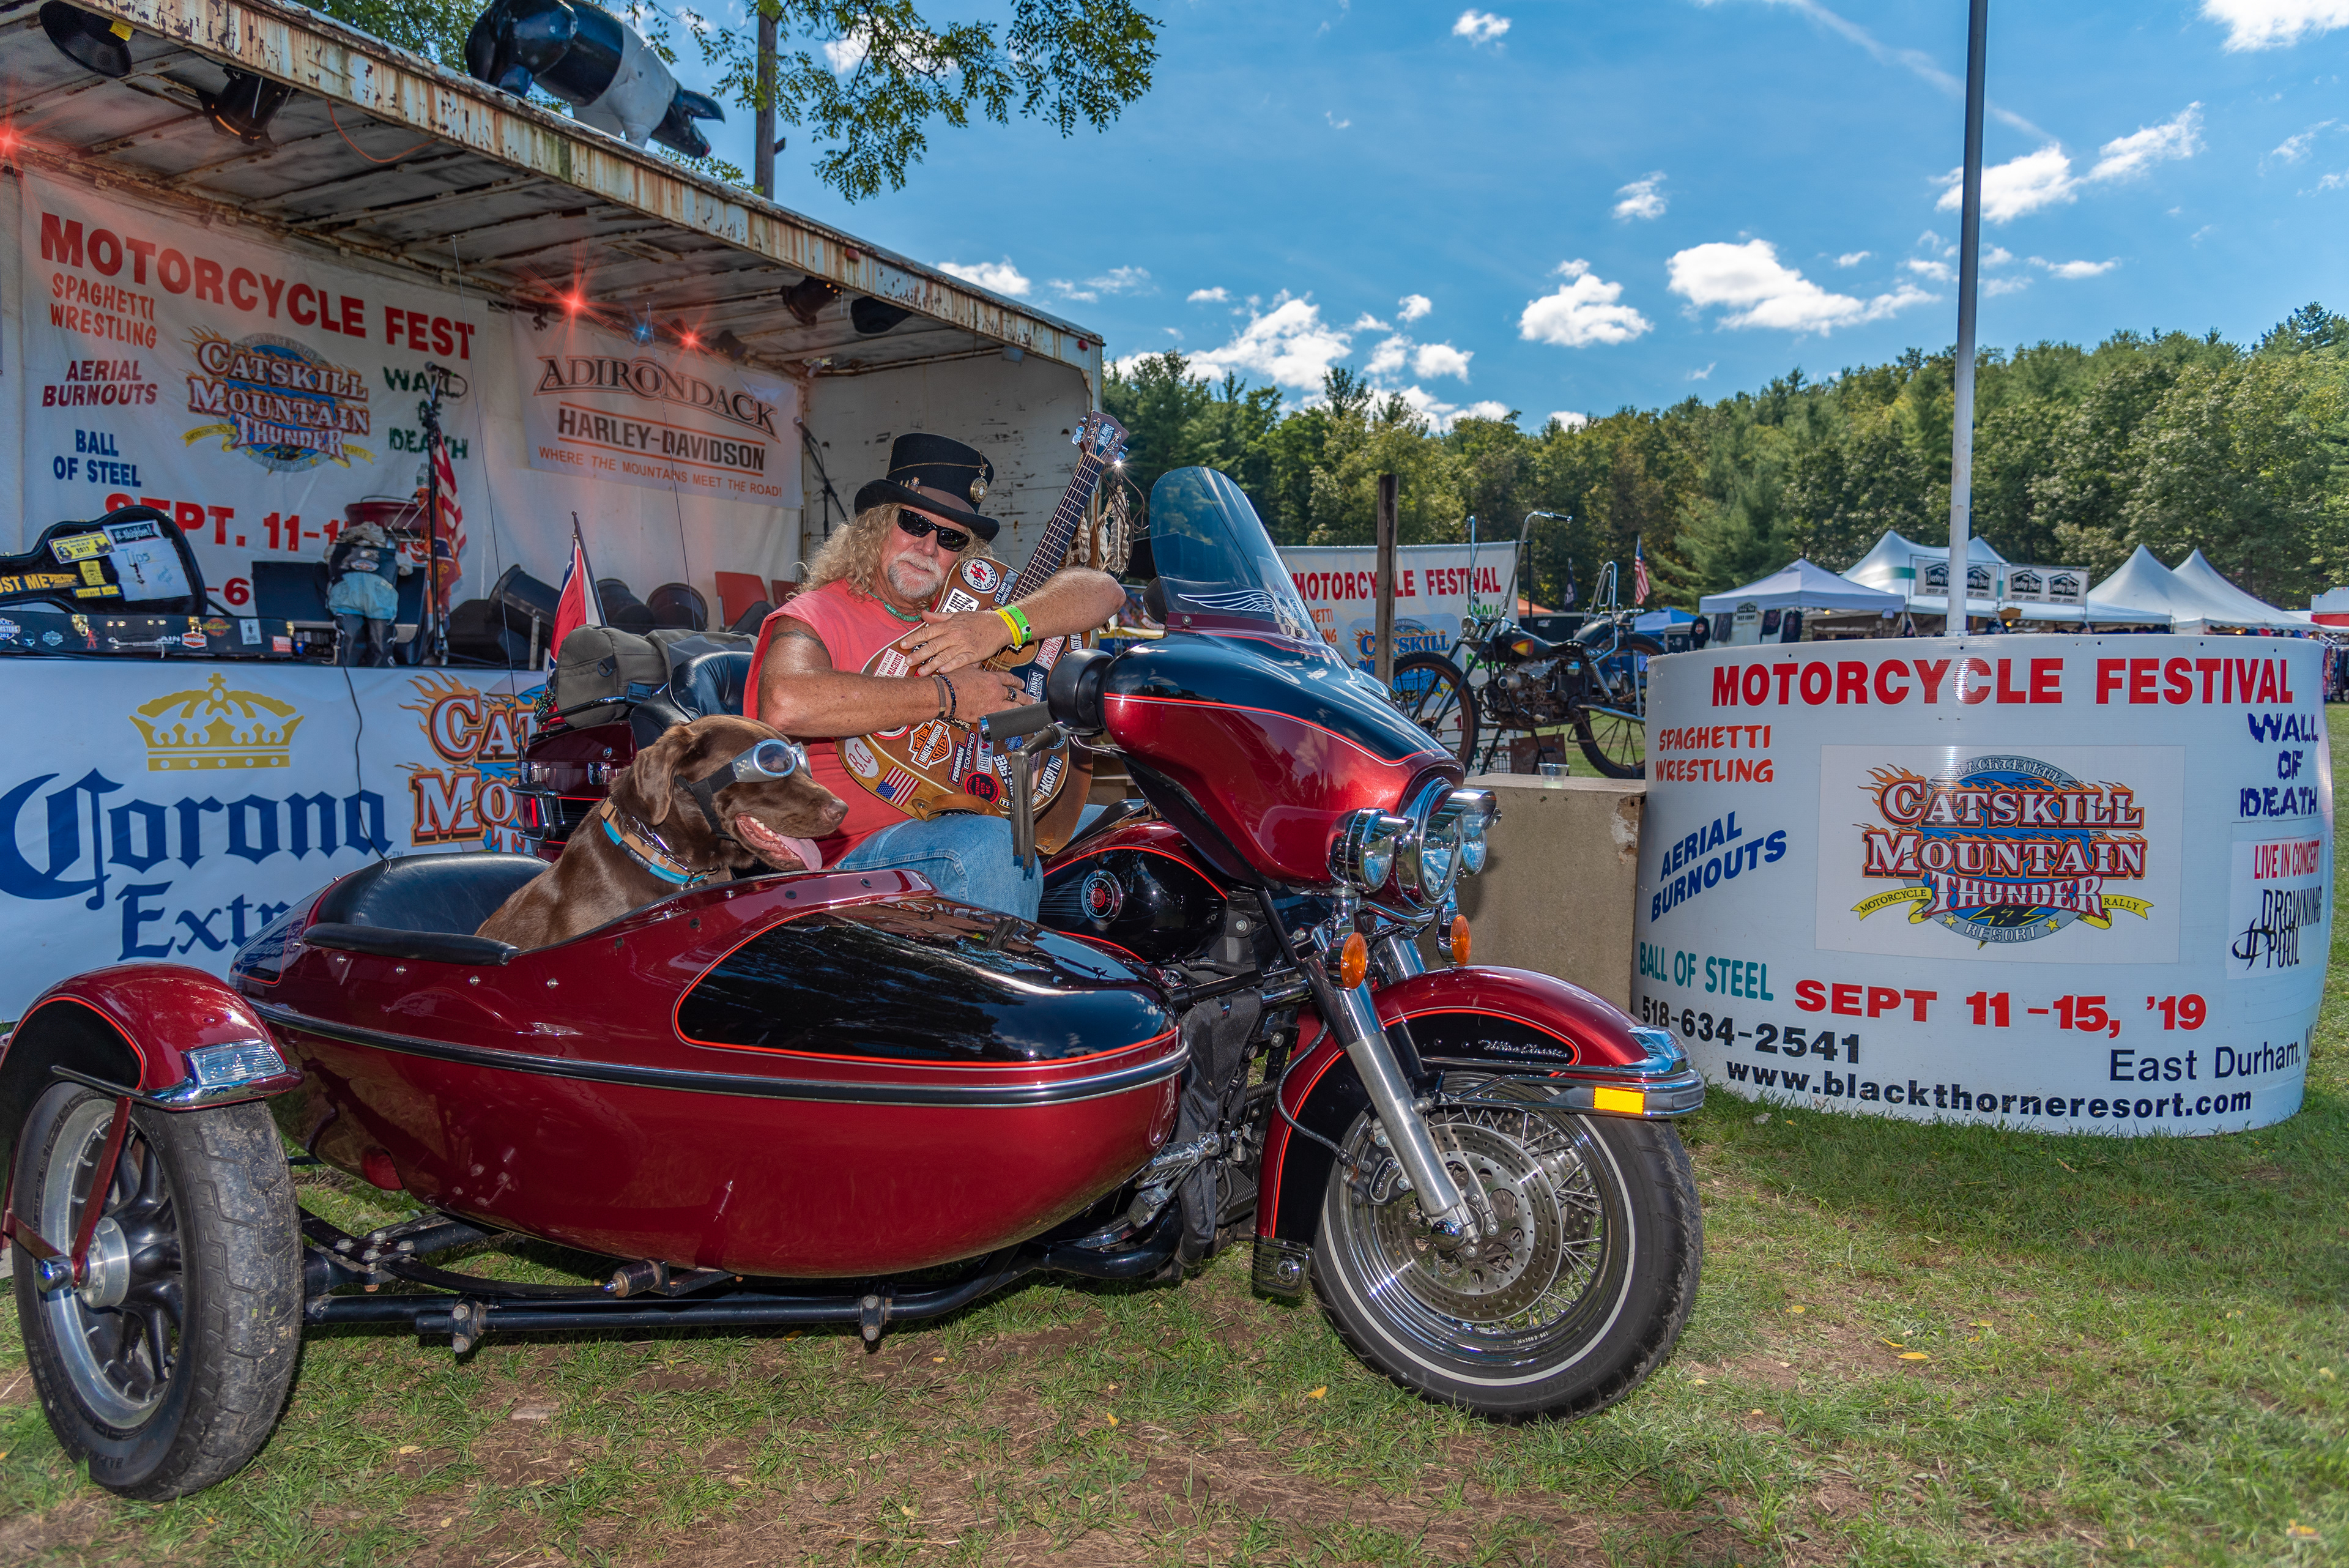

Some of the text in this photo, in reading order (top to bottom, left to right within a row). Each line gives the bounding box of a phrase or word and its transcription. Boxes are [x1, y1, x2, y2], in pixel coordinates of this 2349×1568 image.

[41, 212, 475, 360] MOTORCYCLE FEST
[52, 272, 154, 321] SPAGHETTI
[50, 303, 157, 349] WRESTLING
[65, 360, 141, 381] AERIAL
[198, 341, 368, 401] CATSKILL
[42, 384, 158, 407] BURNOUTS
[186, 376, 369, 436] MOUNTAIN
[534, 356, 781, 443] ADIRONDACK
[75, 429, 119, 457] BALL
[232, 414, 349, 462] THUNDER
[557, 407, 765, 472] HARLEY-DAVIDSON
[53, 456, 141, 487] OF STEEL
[538, 446, 782, 497] WHERE THE MOUNTAINS MEET THE ROAD!
[263, 512, 348, 551] 11-1
[120, 548, 150, 569] Tips
[24, 574, 50, 590] ME
[984, 568, 995, 589] LOWELL
[998, 581, 1008, 595] THEM
[1292, 570, 1416, 601] MOTORCYLE
[879, 650, 894, 672] YOUR LOCAL
[887, 653, 904, 677] MACHINE
[1046, 638, 1061, 666] PAINFUL
[1030, 672, 1044, 695] JONES
[1712, 657, 2295, 707] MOTORCYCLE FESTIVAL
[915, 724, 931, 749] MOTOR
[918, 723, 944, 764] HARLEY-DAVIDSON
[1658, 724, 1772, 751] SPAGHETTI
[2247, 713, 2319, 743] WALL
[932, 737, 947, 761] CYCLES
[951, 745, 965, 782] FISHMAN
[963, 732, 976, 770] EQUIPPED
[979, 754, 989, 767] HAVE
[992, 754, 1009, 777] FREE
[2277, 749, 2304, 780] OF
[1655, 758, 1774, 783] WRESTLING
[1879, 779, 2144, 830] CATSKILL
[2240, 786, 2318, 818] DEATH
[0, 768, 394, 910] Corona
[1660, 811, 1743, 882] AERIAL
[1862, 830, 2147, 879] MOUNTAIN
[1651, 830, 1787, 923] BURNOUTS
[2254, 839, 2320, 879] LIVE IN CONCERT
[1860, 889, 1927, 912] MOTORCYCLE
[1923, 871, 2109, 920] THUNDER
[2104, 897, 2140, 911] RALLY
[2261, 885, 2322, 931] DROWNING
[115, 880, 293, 962] Extr
[1965, 923, 2039, 941] RESORT
[2266, 927, 2300, 968] POOL
[1639, 942, 1774, 1002] BALL OF STEEL
[1794, 979, 1938, 1022] SEPT
[1965, 990, 2011, 1027] 11
[2146, 994, 2207, 1030] '19
[1642, 995, 1860, 1065] 518-634-2541
[2109, 1048, 2198, 1082] East
[2214, 1040, 2301, 1080] Durham,
[1727, 1060, 2252, 1119] www.blackthorneresort.com
